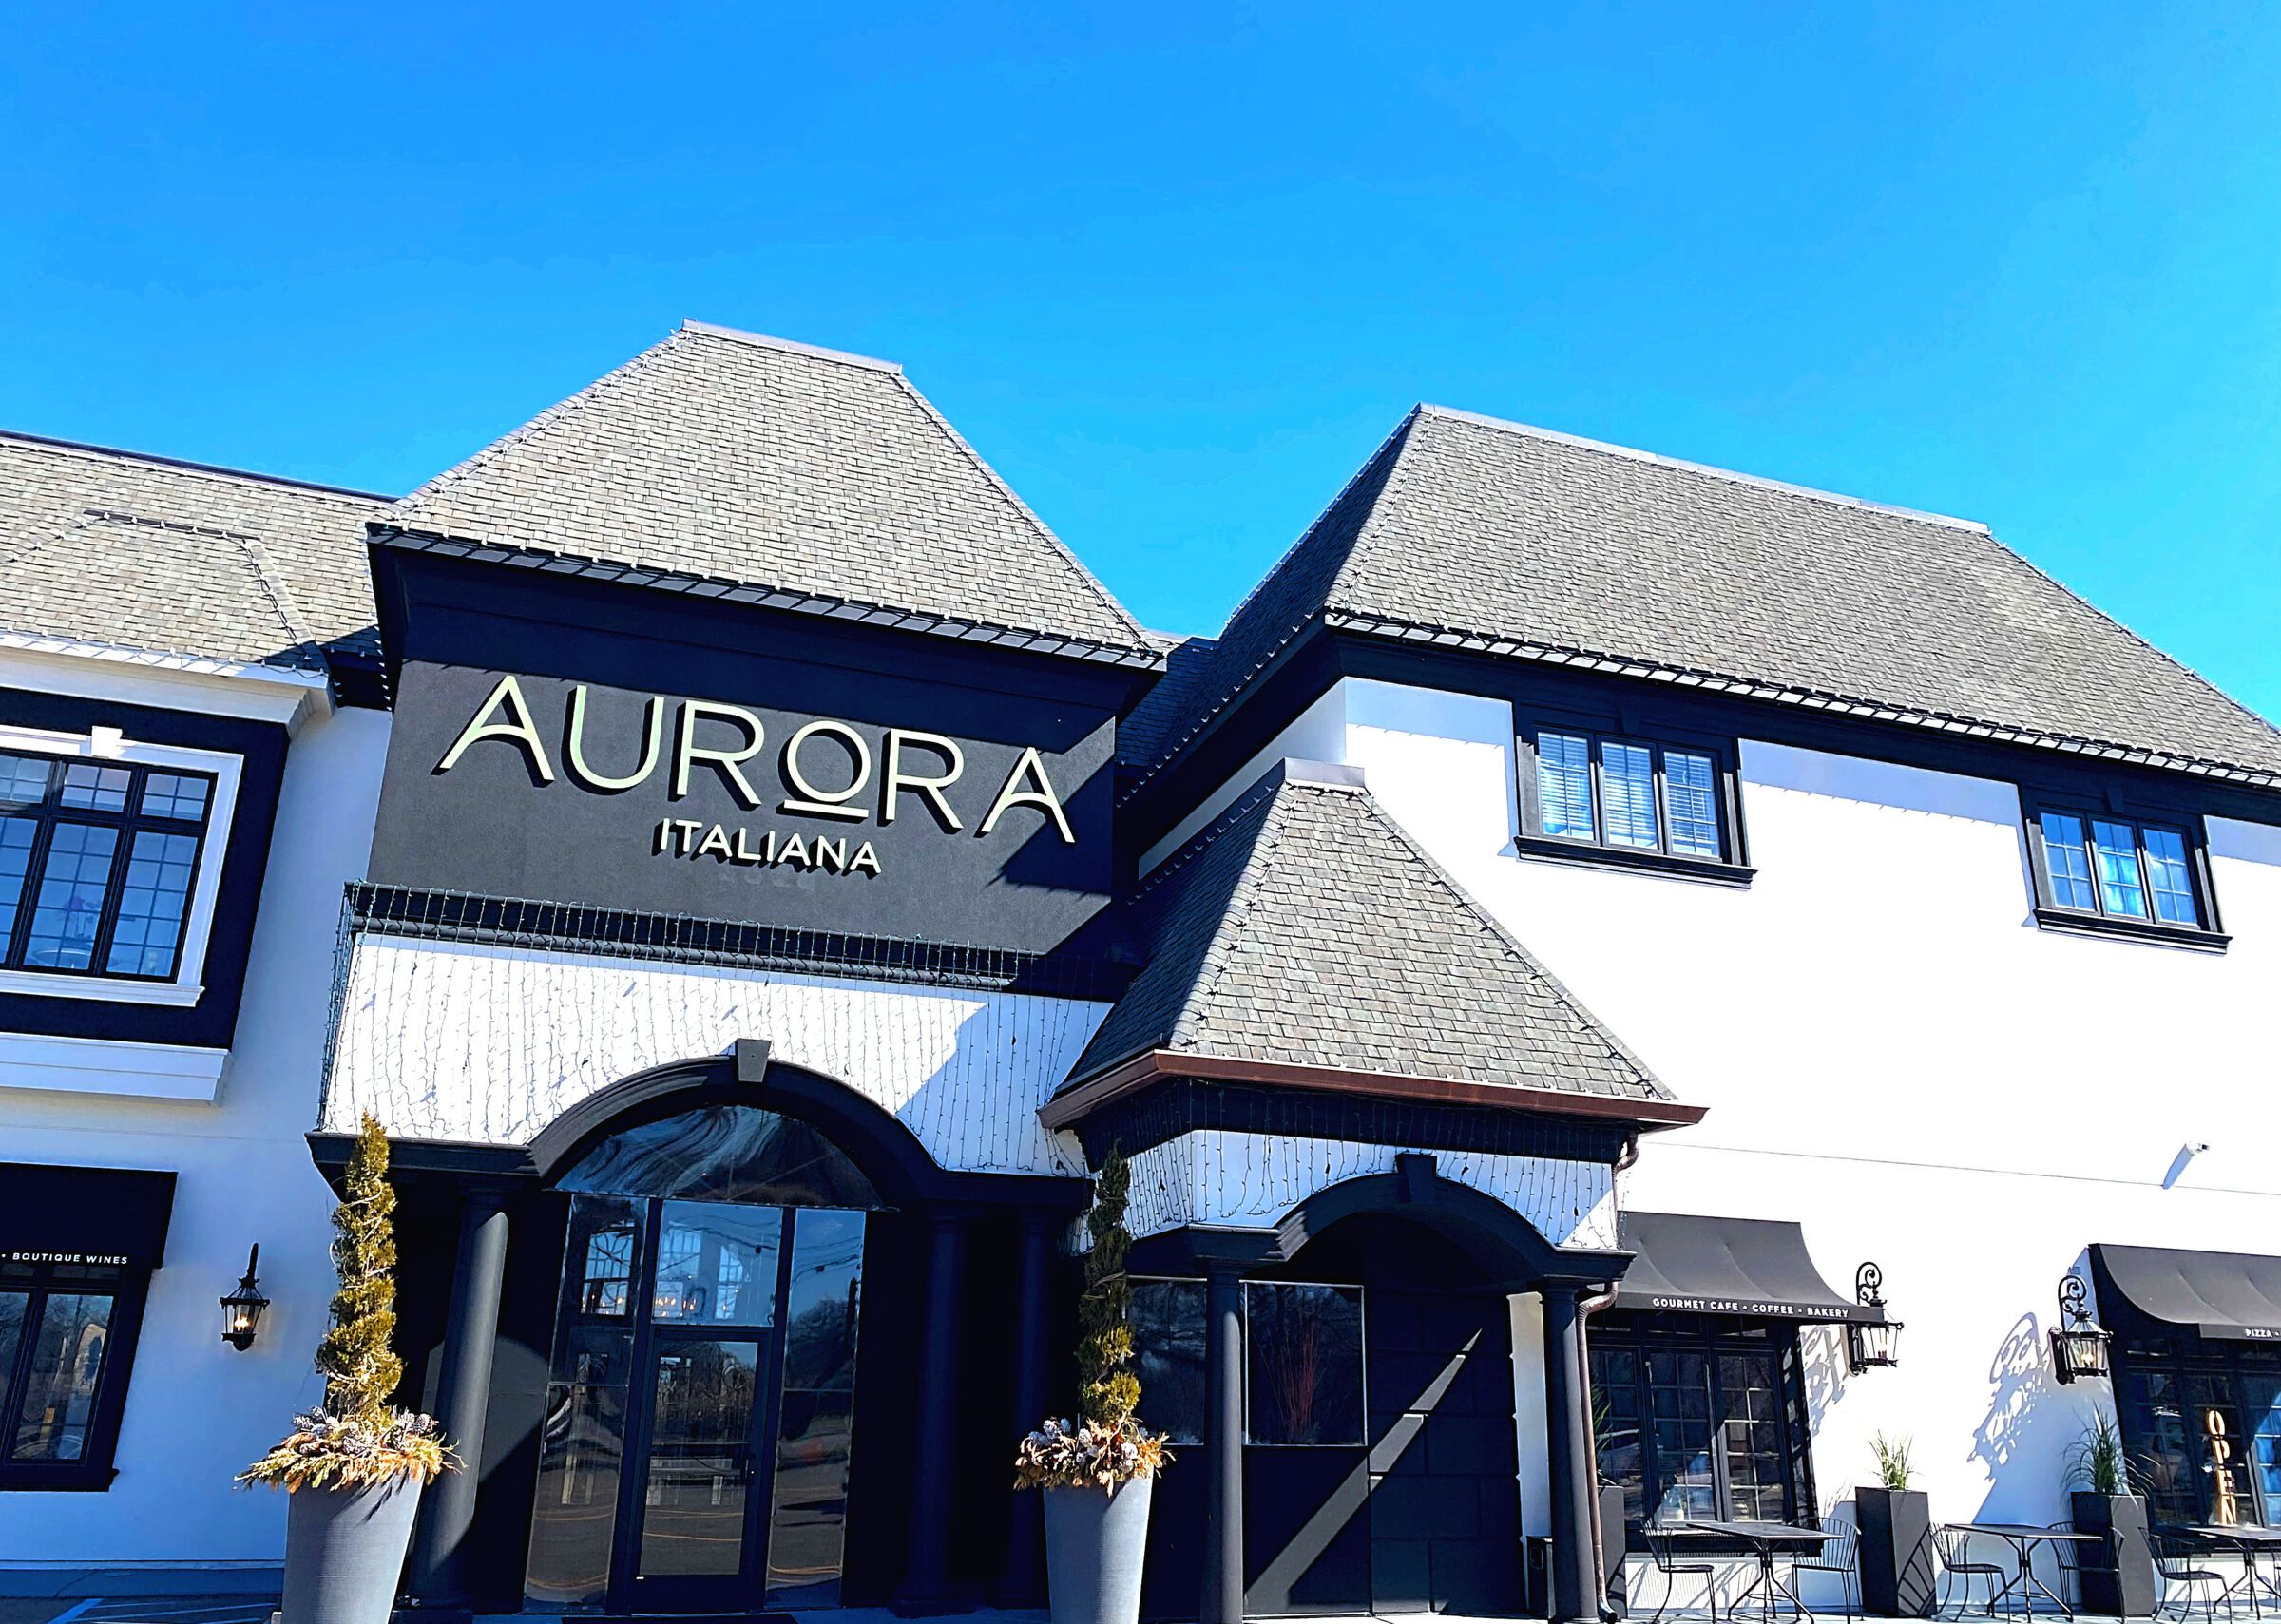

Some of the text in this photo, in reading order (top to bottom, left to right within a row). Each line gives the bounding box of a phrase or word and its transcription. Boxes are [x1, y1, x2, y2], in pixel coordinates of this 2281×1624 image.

[439, 676, 1075, 844] AURORA
[660, 817, 881, 874] ITALIANA
[12, 1252, 128, 1265] BOUTIQUE WINES
[1653, 1298, 1849, 1319] GOURMET CAFE COFFEE BAKERY
[2245, 1328, 2273, 1338] PIZZA
[2206, 1409, 2237, 1525] OPEN
